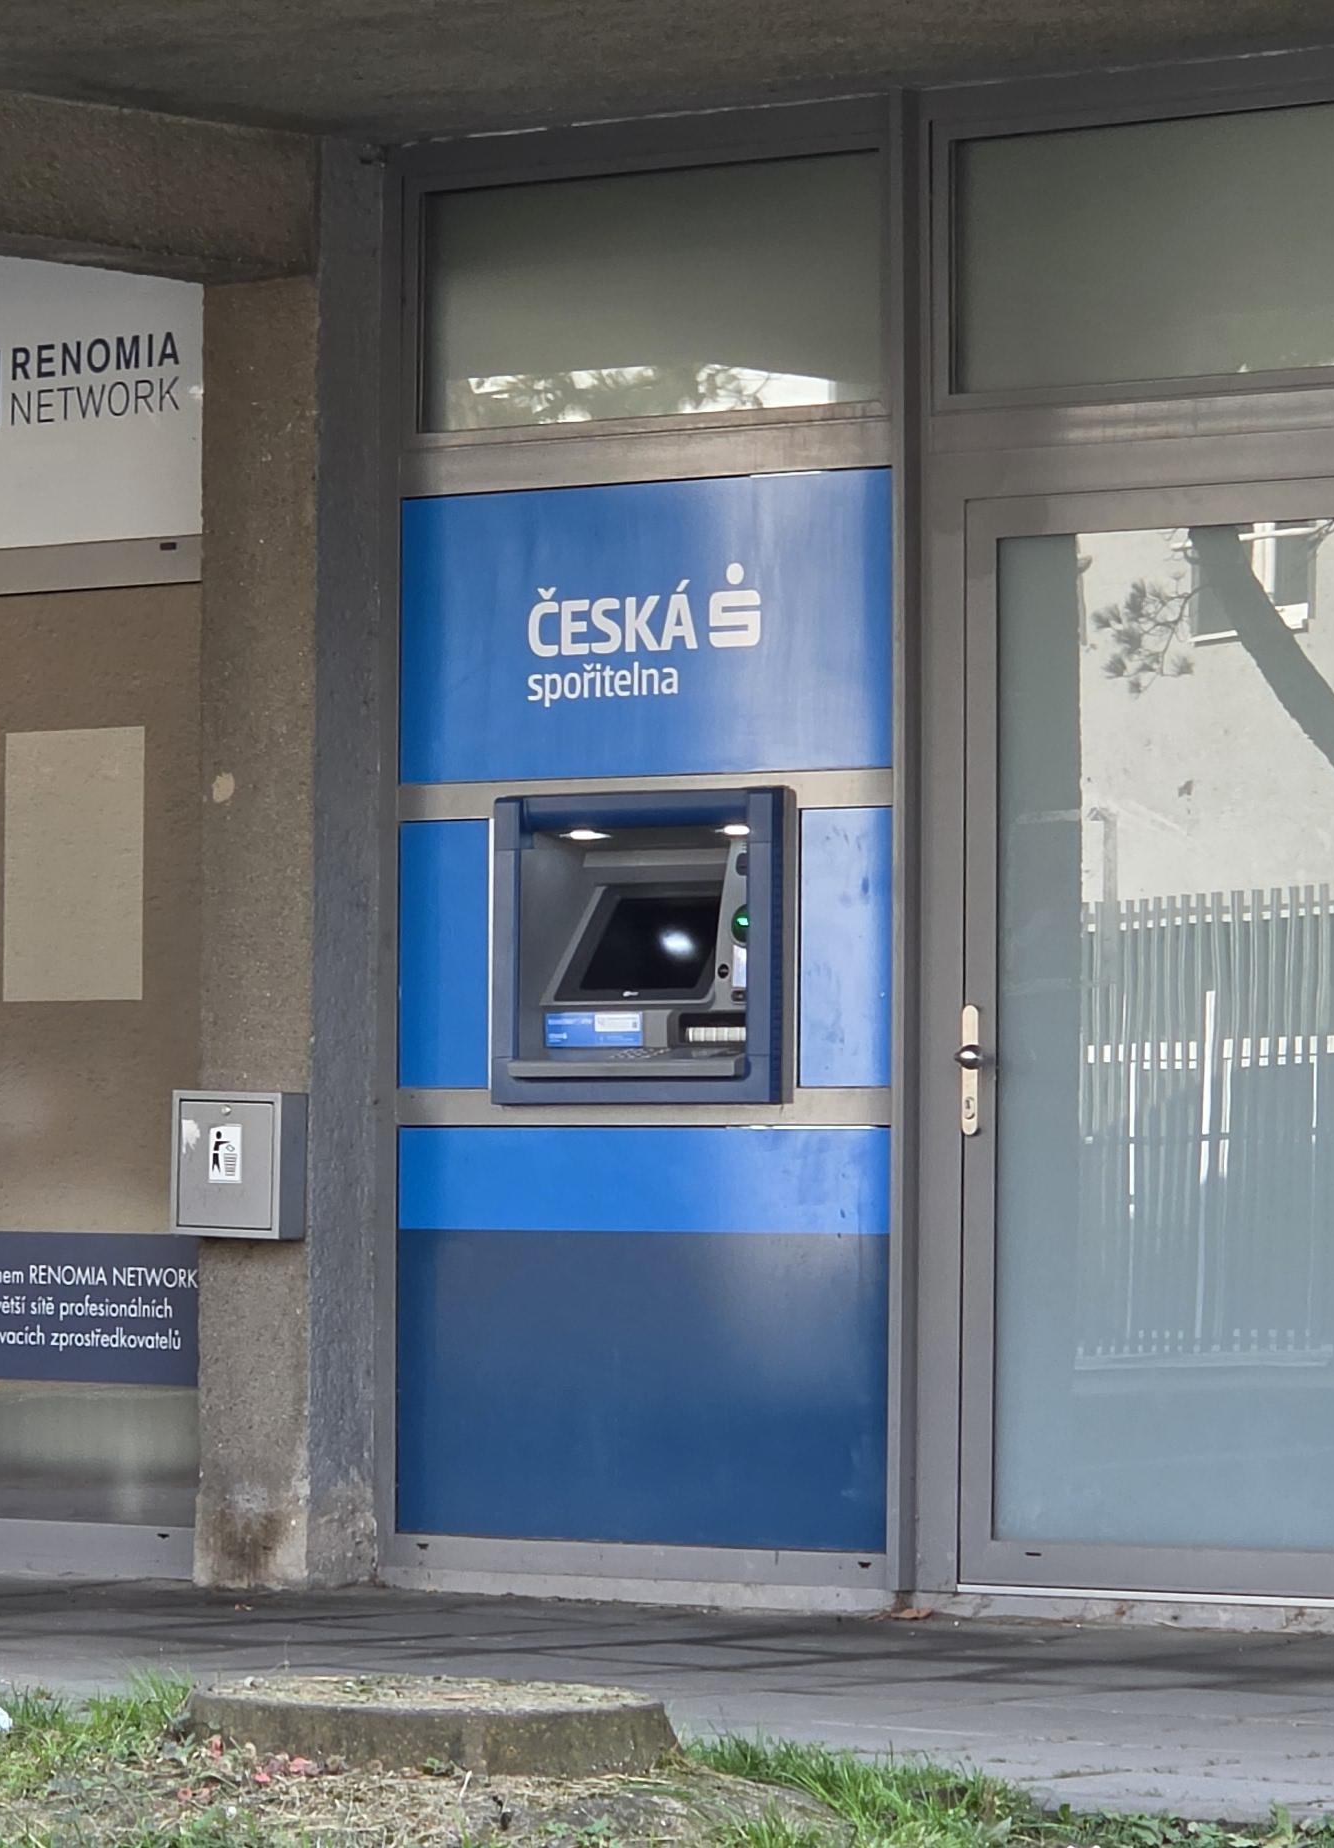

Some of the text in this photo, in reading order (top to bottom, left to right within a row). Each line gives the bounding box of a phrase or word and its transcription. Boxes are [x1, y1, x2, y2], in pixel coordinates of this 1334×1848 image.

[10, 331, 179, 381] RENOMIA
[9, 376, 180, 426] NETWORK
[527, 579, 698, 657] ČESKÁ
[526, 661, 679, 707] spořitelna
[29, 1264, 107, 1286] RENOMIA
[112, 1266, 198, 1288] NETWORK
[30, 1296, 54, 1315] sítě
[59, 1294, 173, 1320] profesionálních
[50, 1325, 181, 1351] zprostředkovatelů
